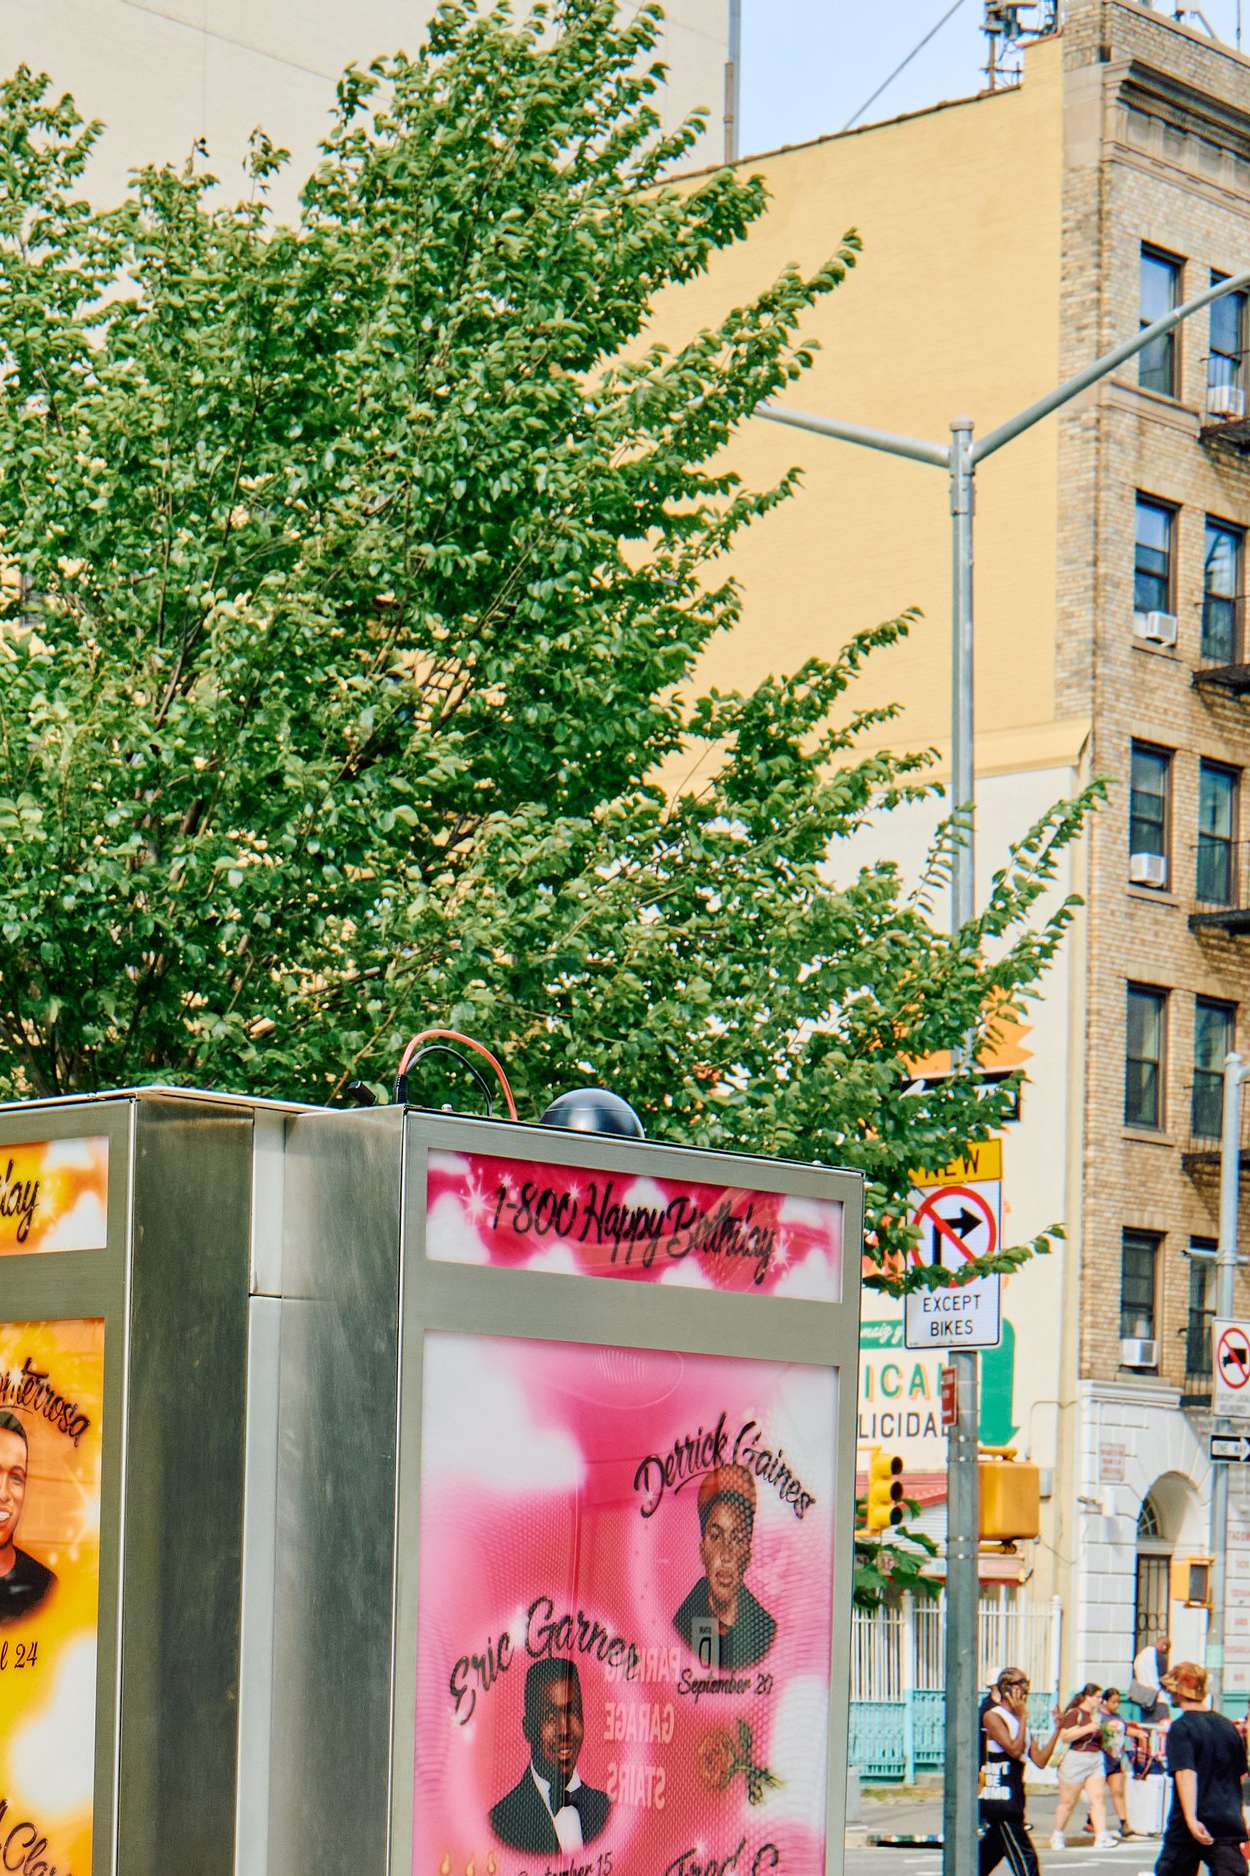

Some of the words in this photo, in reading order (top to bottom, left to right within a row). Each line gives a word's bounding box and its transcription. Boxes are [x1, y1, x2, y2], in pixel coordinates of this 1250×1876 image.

[492, 1181, 578, 1239] 1-800
[579, 1180, 666, 1268] Happy
[664, 1197, 777, 1285] Birthday
[923, 1294, 982, 1313] EXCEPT
[930, 1319, 974, 1337] BIKES
[865, 1362, 942, 1400] ICA
[633, 1411, 729, 1519] Derrick
[731, 1419, 817, 1521] Gaines
[12, 1640, 39, 1669] 24
[449, 1629, 514, 1727] Eric
[524, 1596, 641, 1682] Garner
[677, 1668, 752, 1703] September
